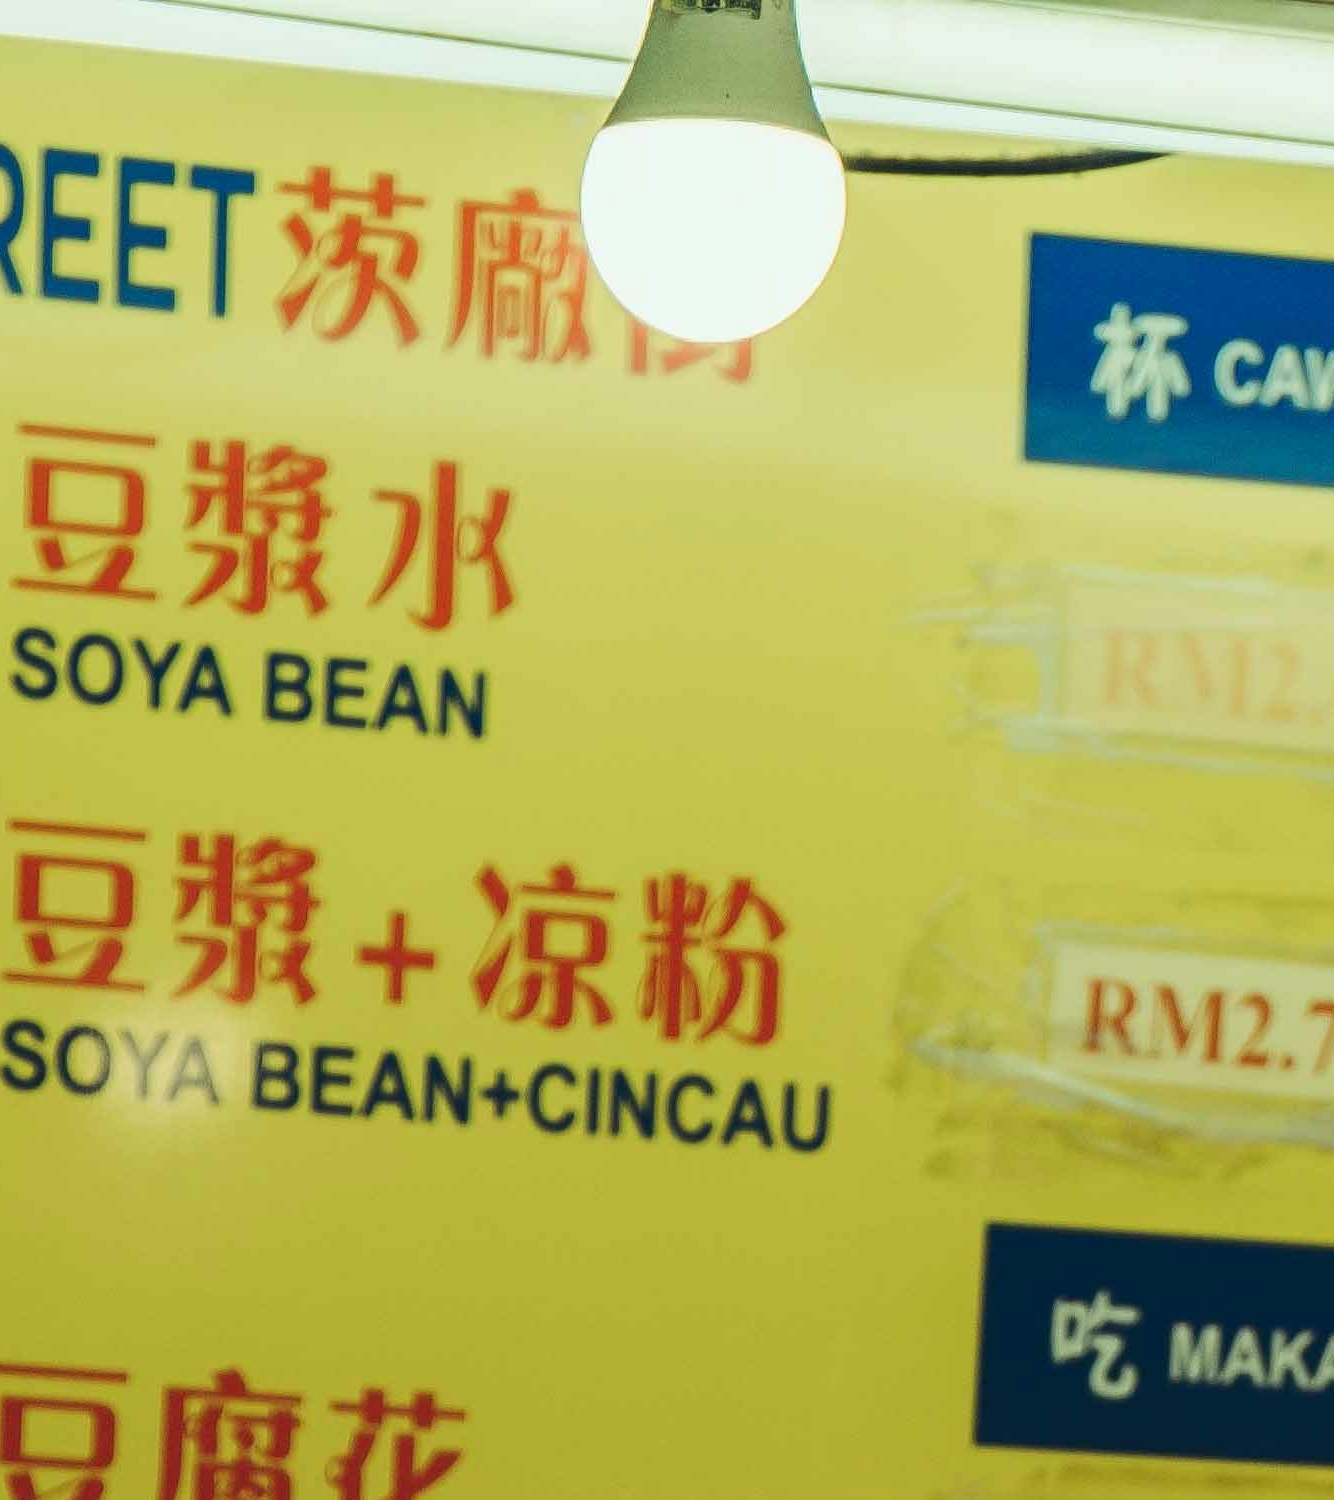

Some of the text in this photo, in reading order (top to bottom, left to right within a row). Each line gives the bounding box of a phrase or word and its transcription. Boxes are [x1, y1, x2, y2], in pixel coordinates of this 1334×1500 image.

[273, 164, 755, 385] 茨廠
[1090, 301, 1190, 422] 杯
[8, 421, 519, 632] 豆漿水
[9, 627, 488, 740] SOYA BEAN
[250, 1039, 832, 1154] BEAN+CINCAU
[1050, 1289, 1142, 1402] 吃
